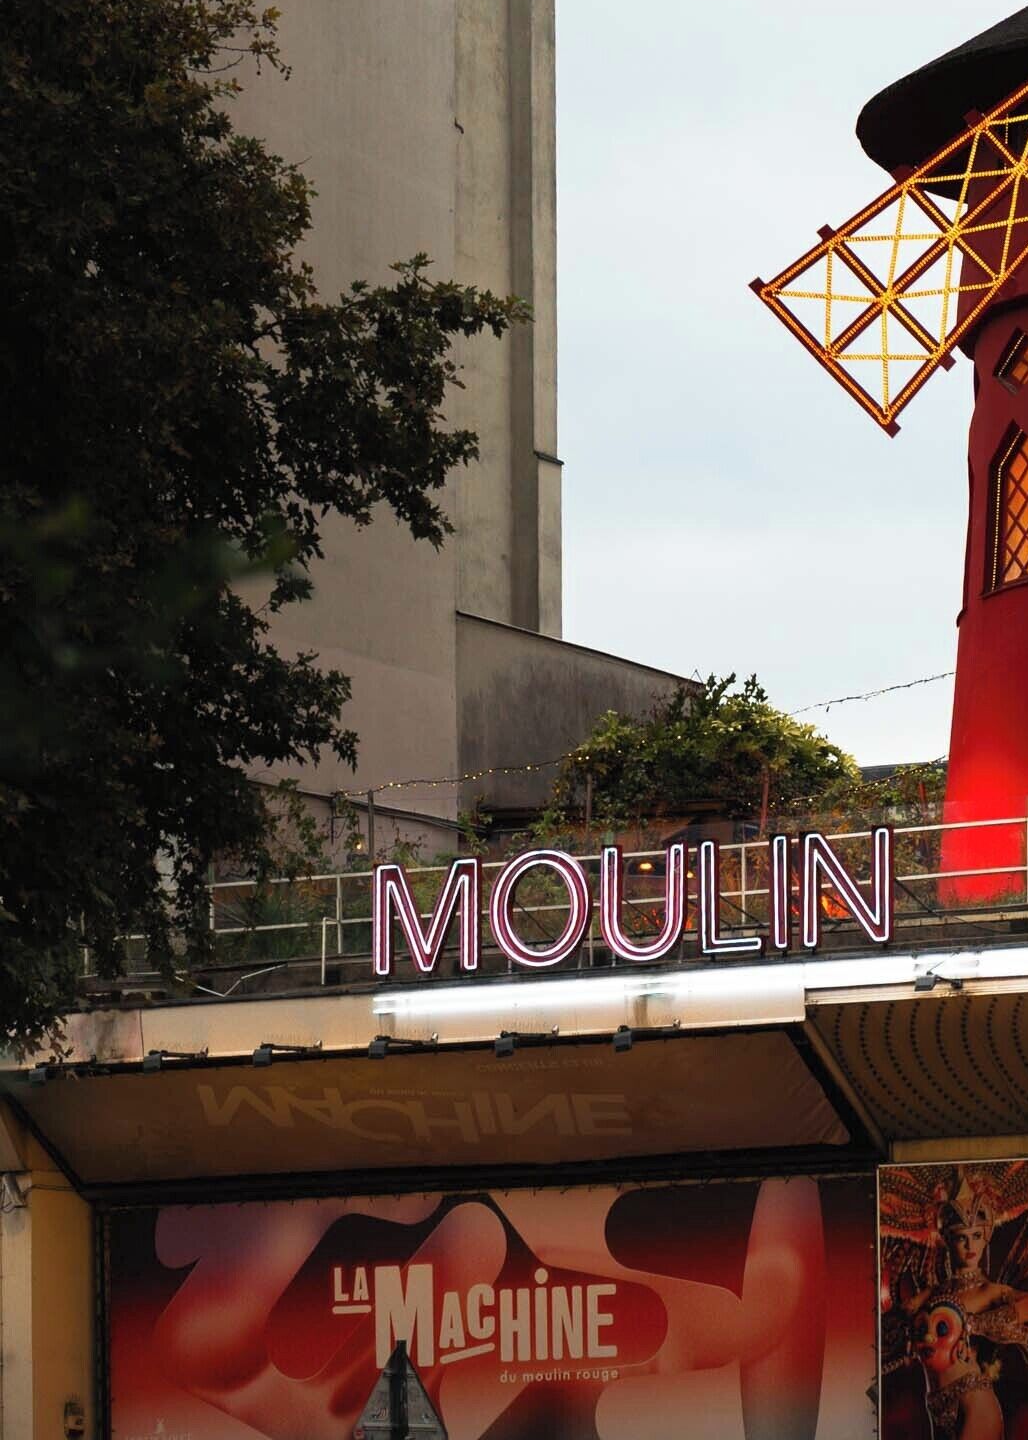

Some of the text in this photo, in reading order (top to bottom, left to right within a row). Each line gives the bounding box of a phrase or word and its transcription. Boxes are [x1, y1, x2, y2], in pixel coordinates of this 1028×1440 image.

[372, 825, 894, 976] MOULIN
[333, 1266, 370, 1302] LA
[499, 1368, 620, 1384] du moulin rouge
